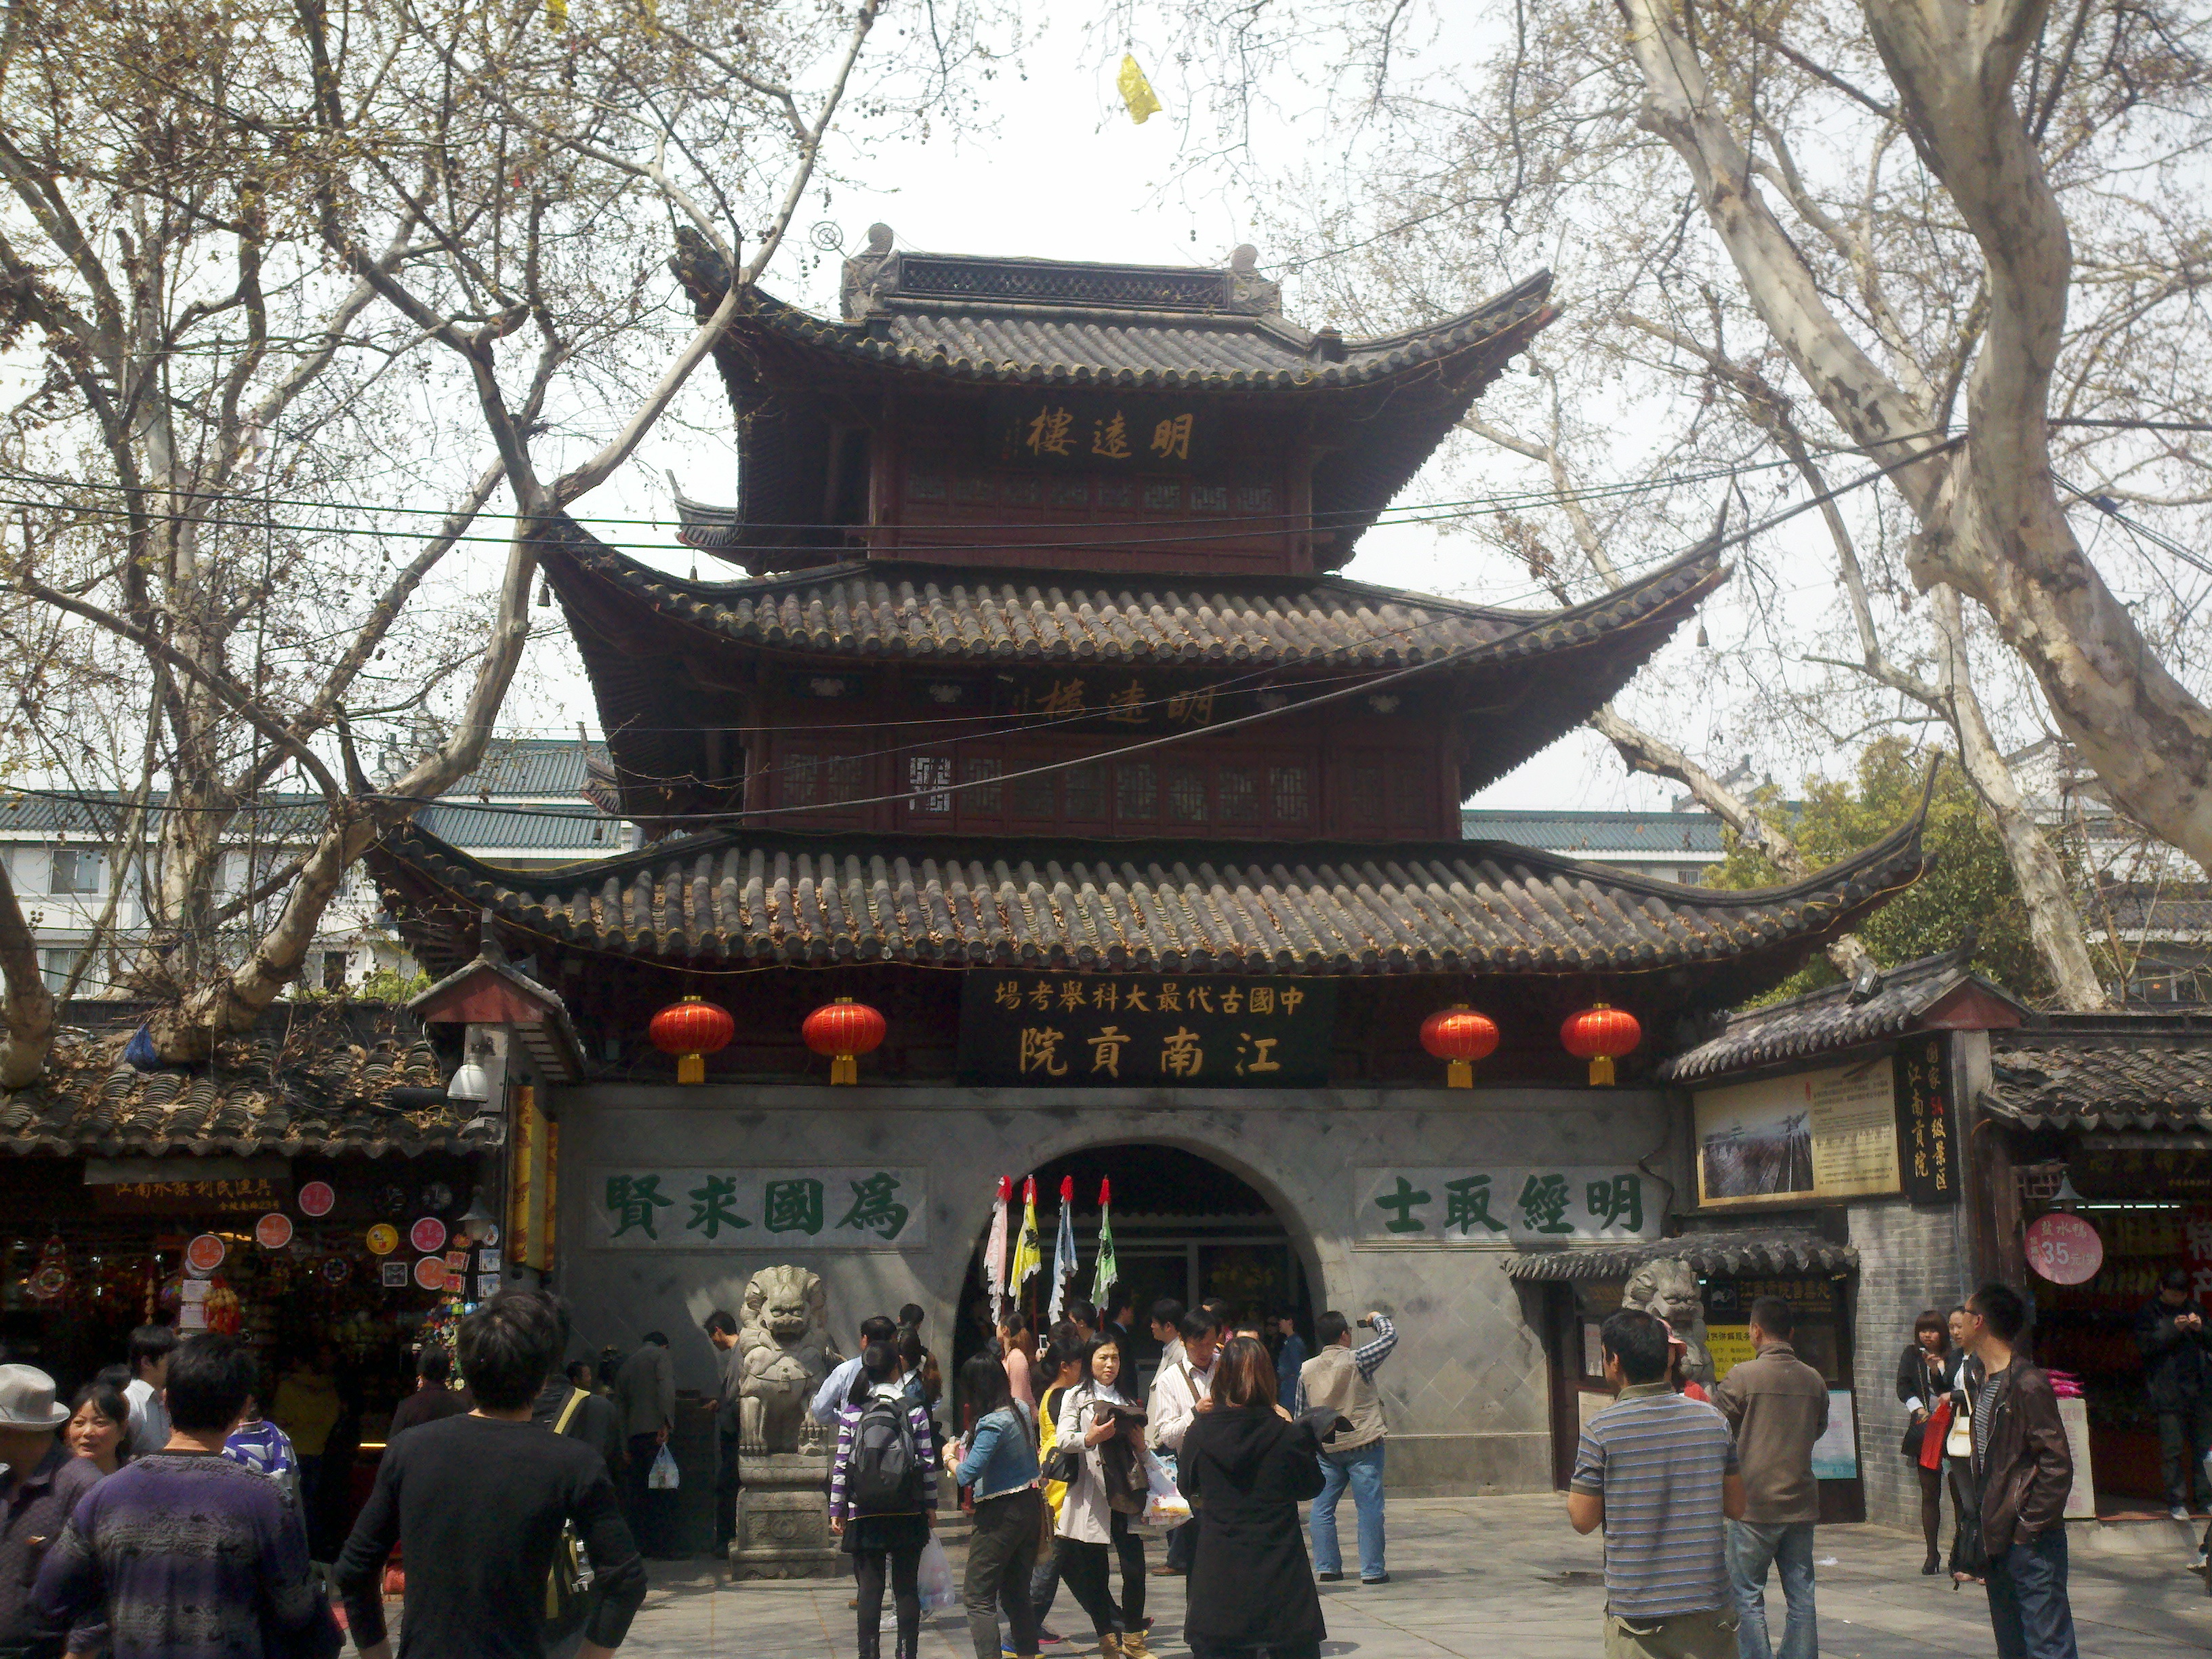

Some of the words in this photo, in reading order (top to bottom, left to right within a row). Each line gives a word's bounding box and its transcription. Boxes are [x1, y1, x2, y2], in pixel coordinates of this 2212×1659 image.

[1019, 1024, 1282, 1078] 江南貢院
[1907, 1059, 1930, 1179] 江南贡院
[1374, 1172, 1645, 1235] 明經取士
